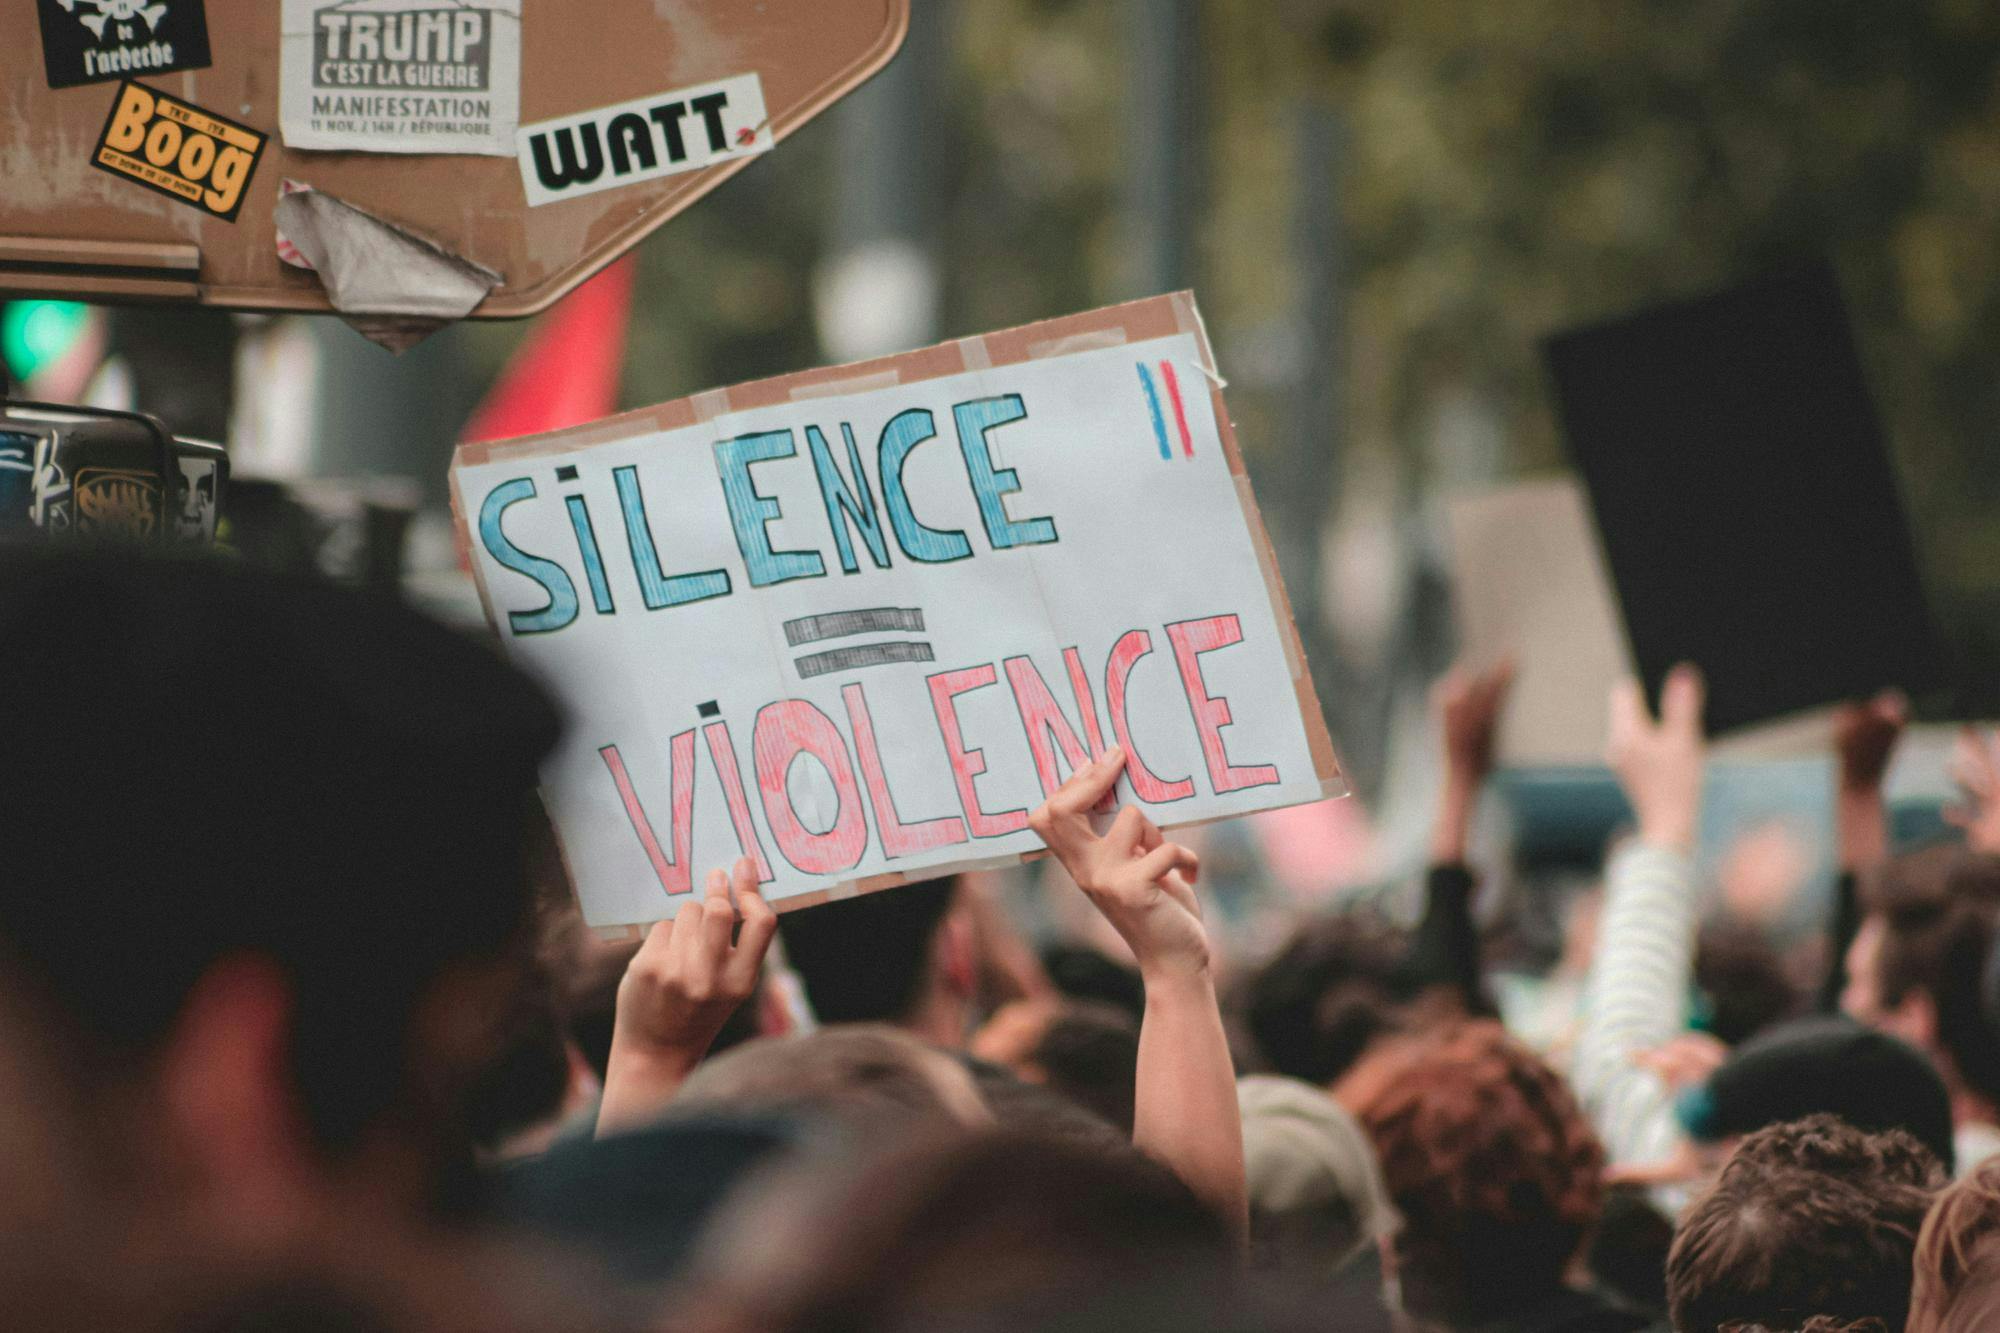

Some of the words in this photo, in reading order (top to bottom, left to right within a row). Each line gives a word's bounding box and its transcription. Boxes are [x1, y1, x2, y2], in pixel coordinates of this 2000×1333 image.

[319, 12, 482, 62] TRUMP
[320, 62, 372, 84] C'EST
[376, 64, 401, 85] LA
[404, 65, 479, 87] GUERRE
[312, 96, 490, 118] MANIFESTATION
[327, 120, 357, 132] NOV.
[411, 119, 491, 135] RÉPUBLIQUE
[106, 84, 253, 213] Boog
